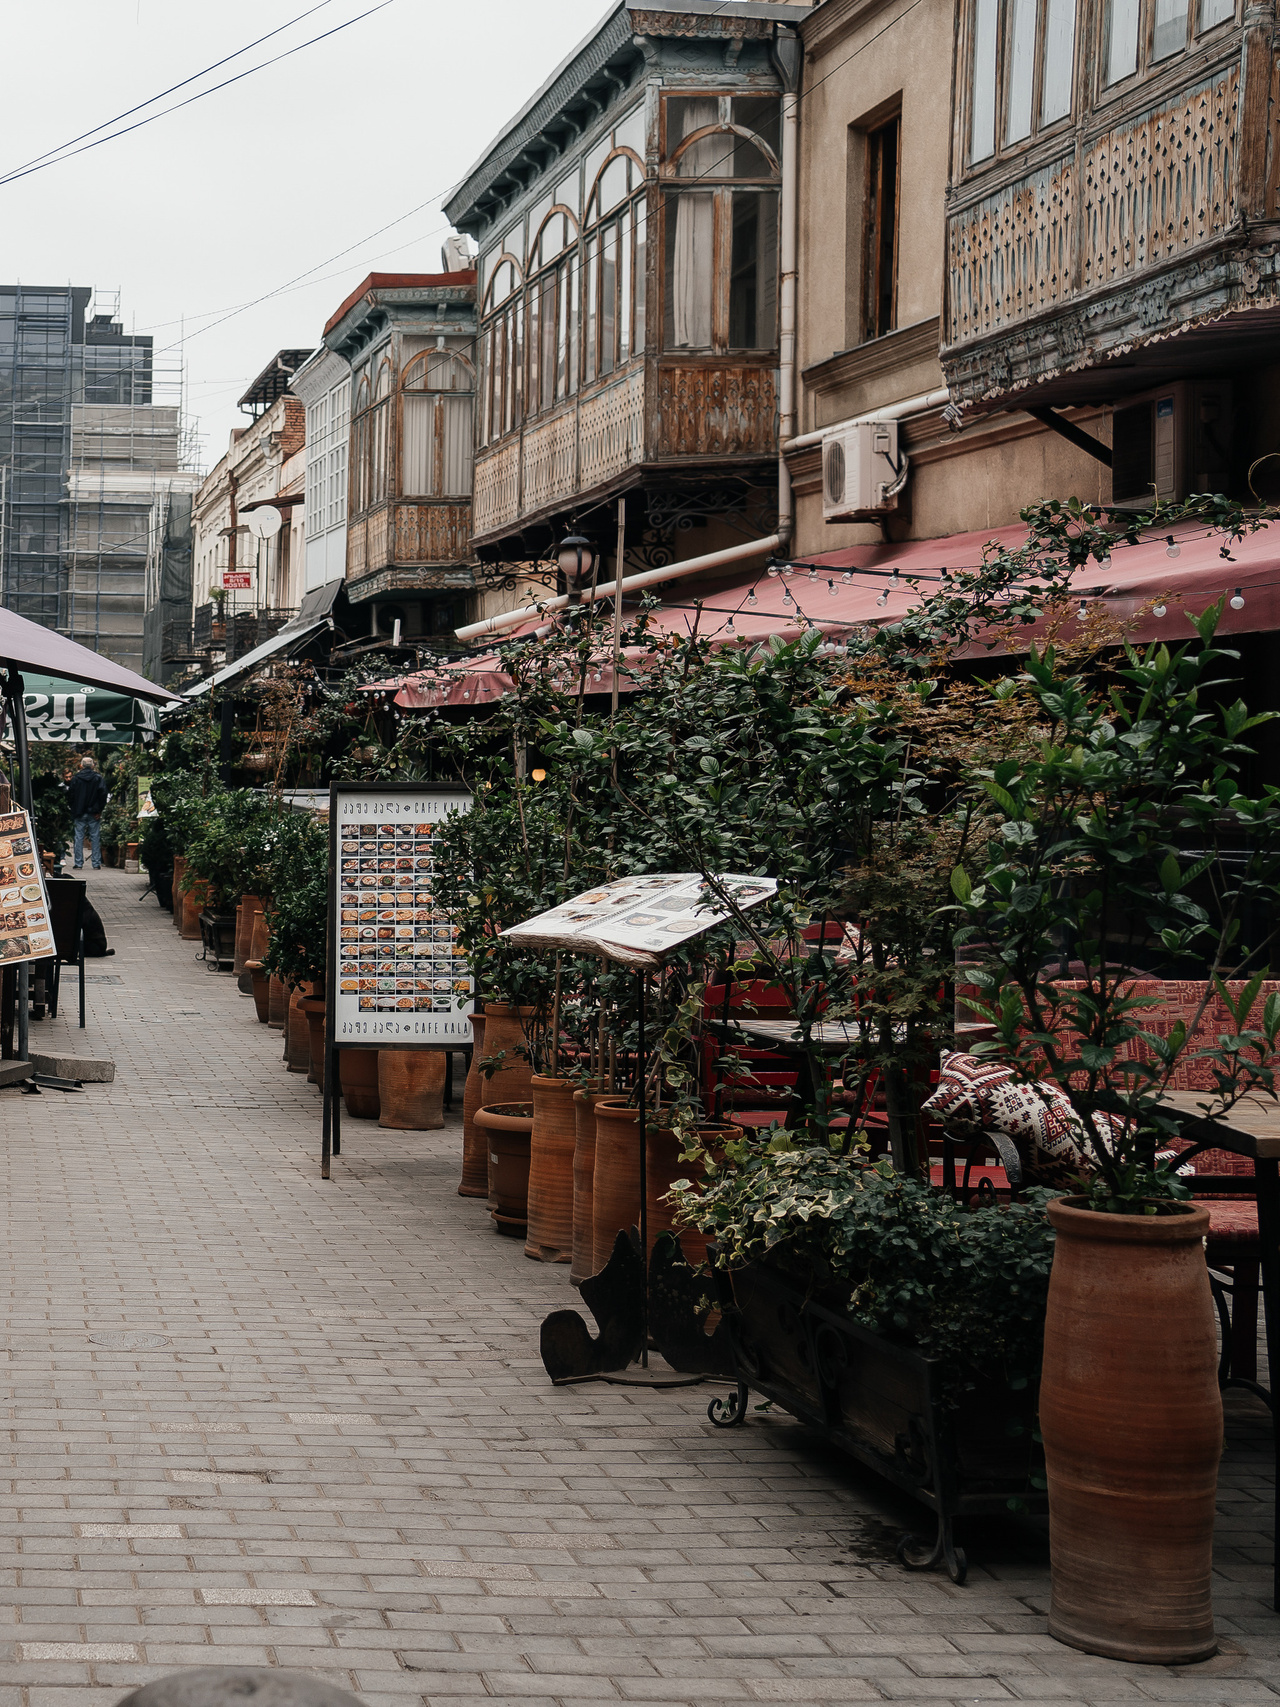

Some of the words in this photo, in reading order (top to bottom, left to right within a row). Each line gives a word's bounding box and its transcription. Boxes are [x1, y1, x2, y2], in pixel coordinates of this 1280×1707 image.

[414, 802, 438, 814] CAFE
[414, 1022, 439, 1034] CAFE
[444, 1022, 468, 1034] KALA
